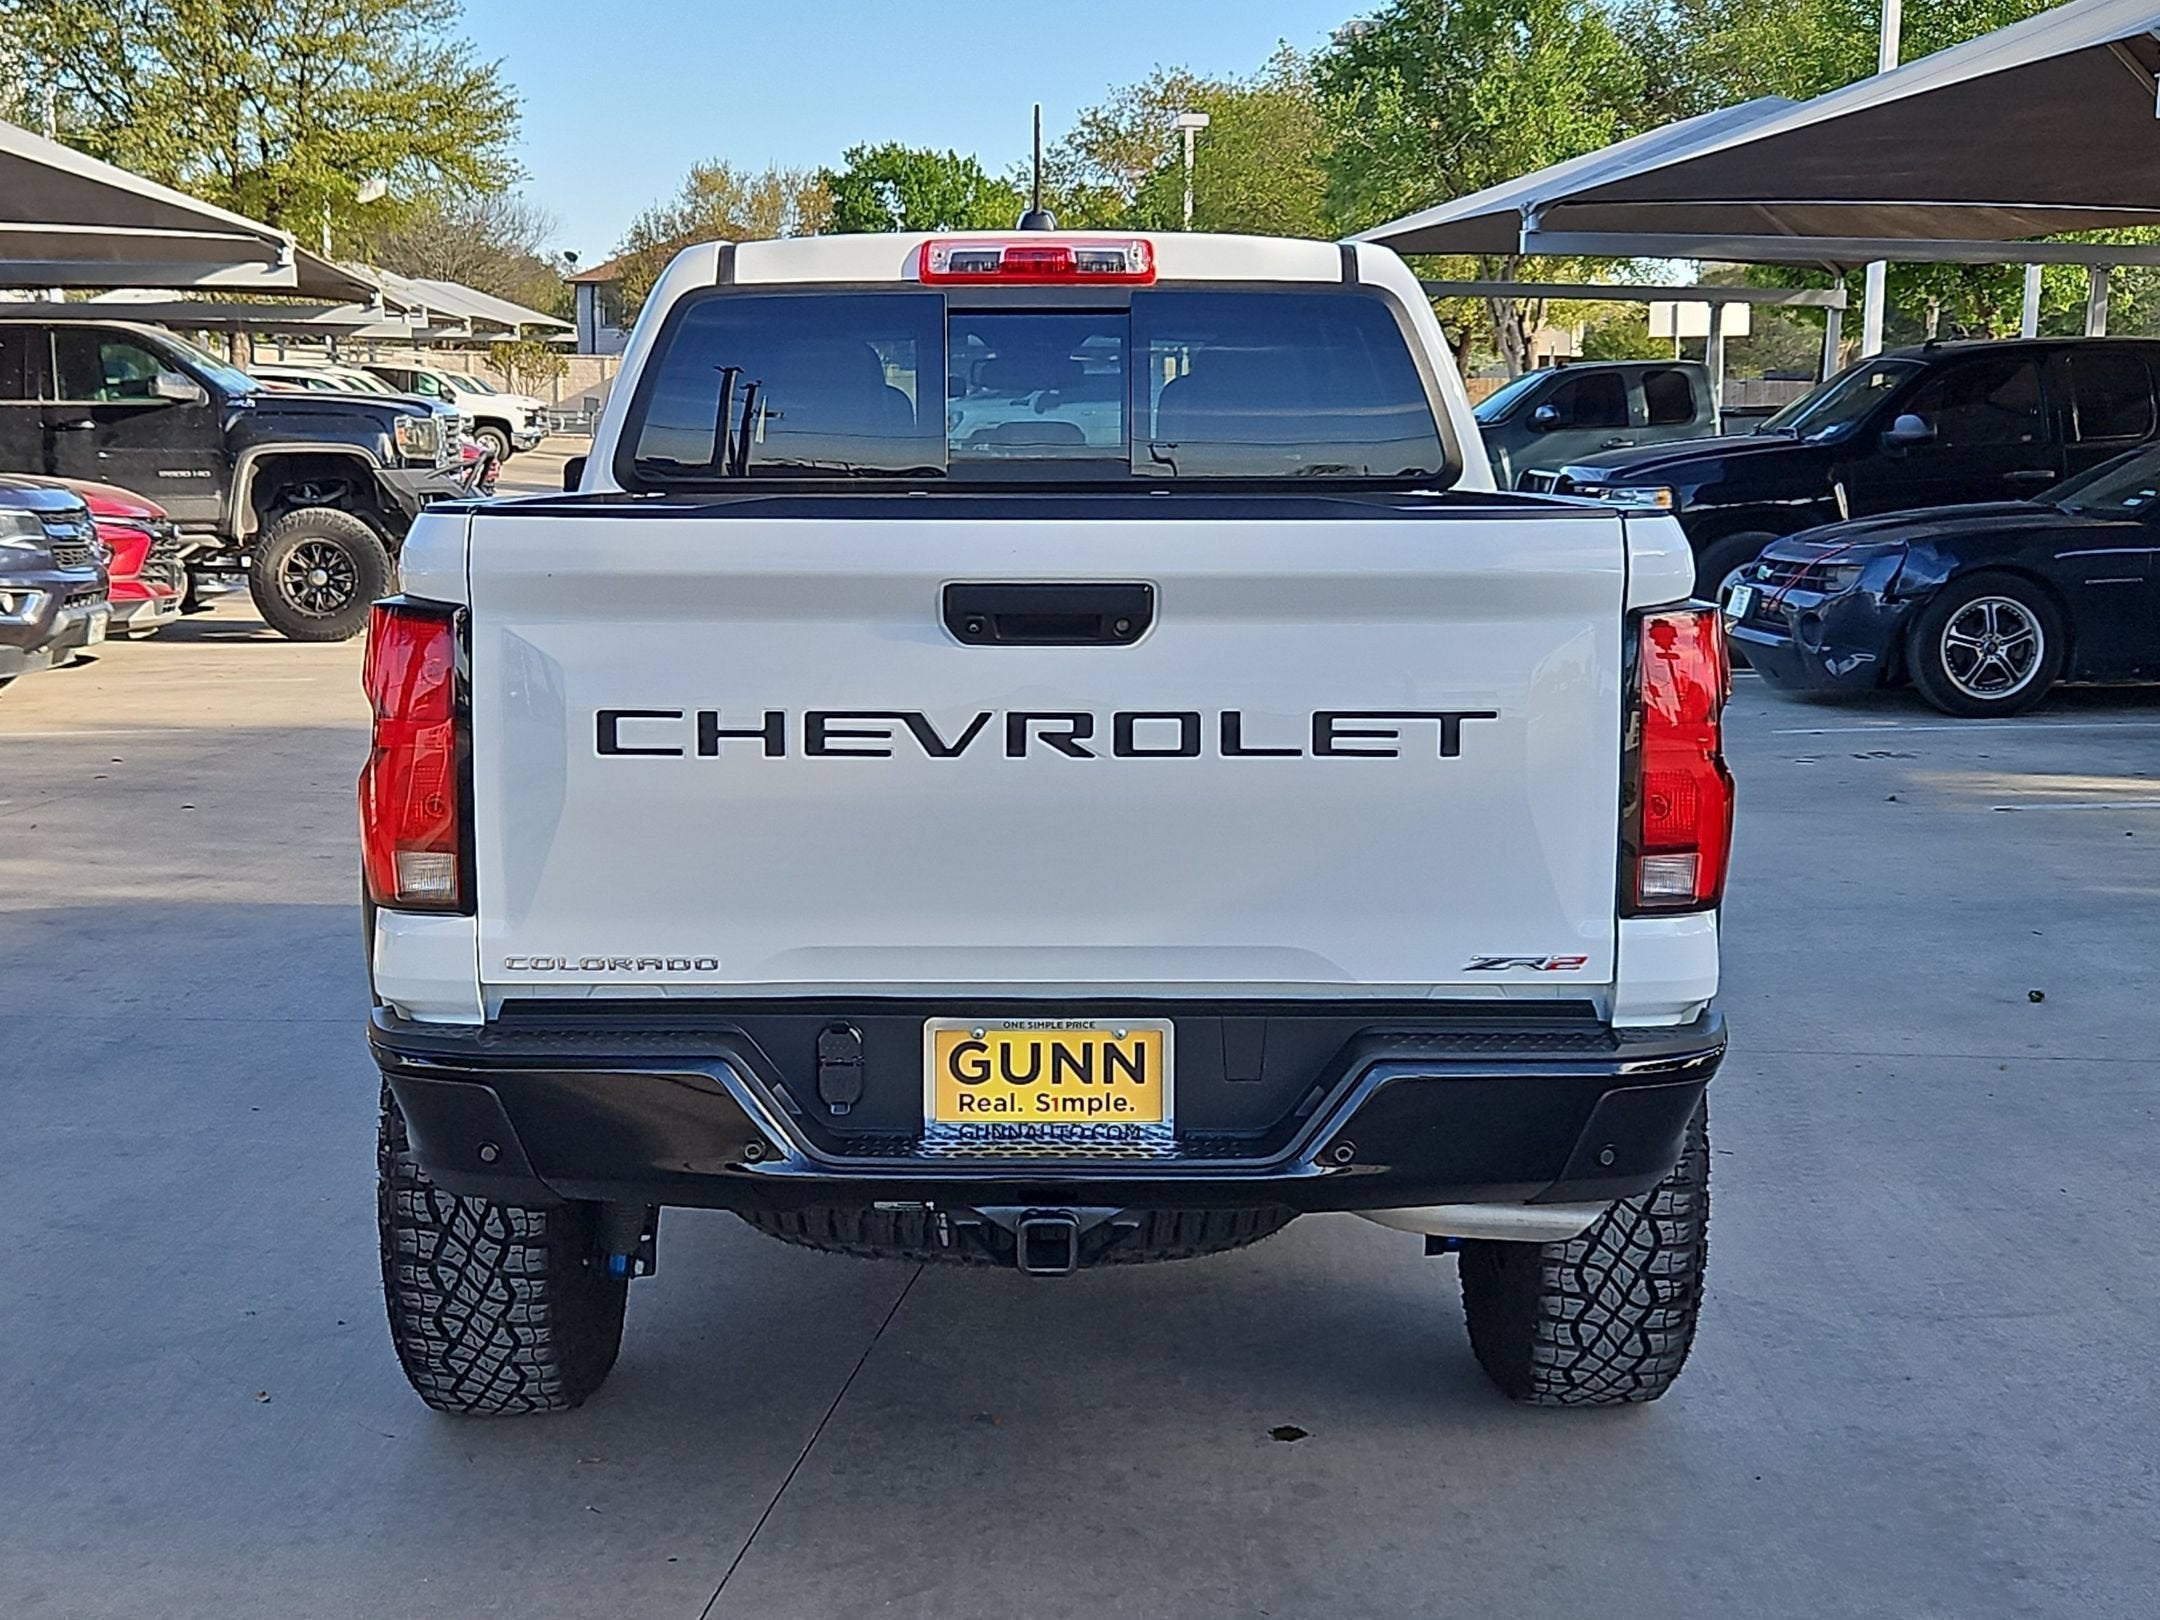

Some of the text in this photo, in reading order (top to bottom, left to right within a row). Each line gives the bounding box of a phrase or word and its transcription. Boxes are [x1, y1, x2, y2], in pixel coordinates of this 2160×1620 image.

[597, 711, 1498, 758] CHEVROLET
[505, 956, 719, 971] COLORADO
[1463, 956, 1588, 971] ZR2
[1003, 1021, 1096, 1029] ONE SIMPLE PRICE
[949, 1041, 1145, 1085] GUNN
[959, 1094, 1024, 1113] Real.
